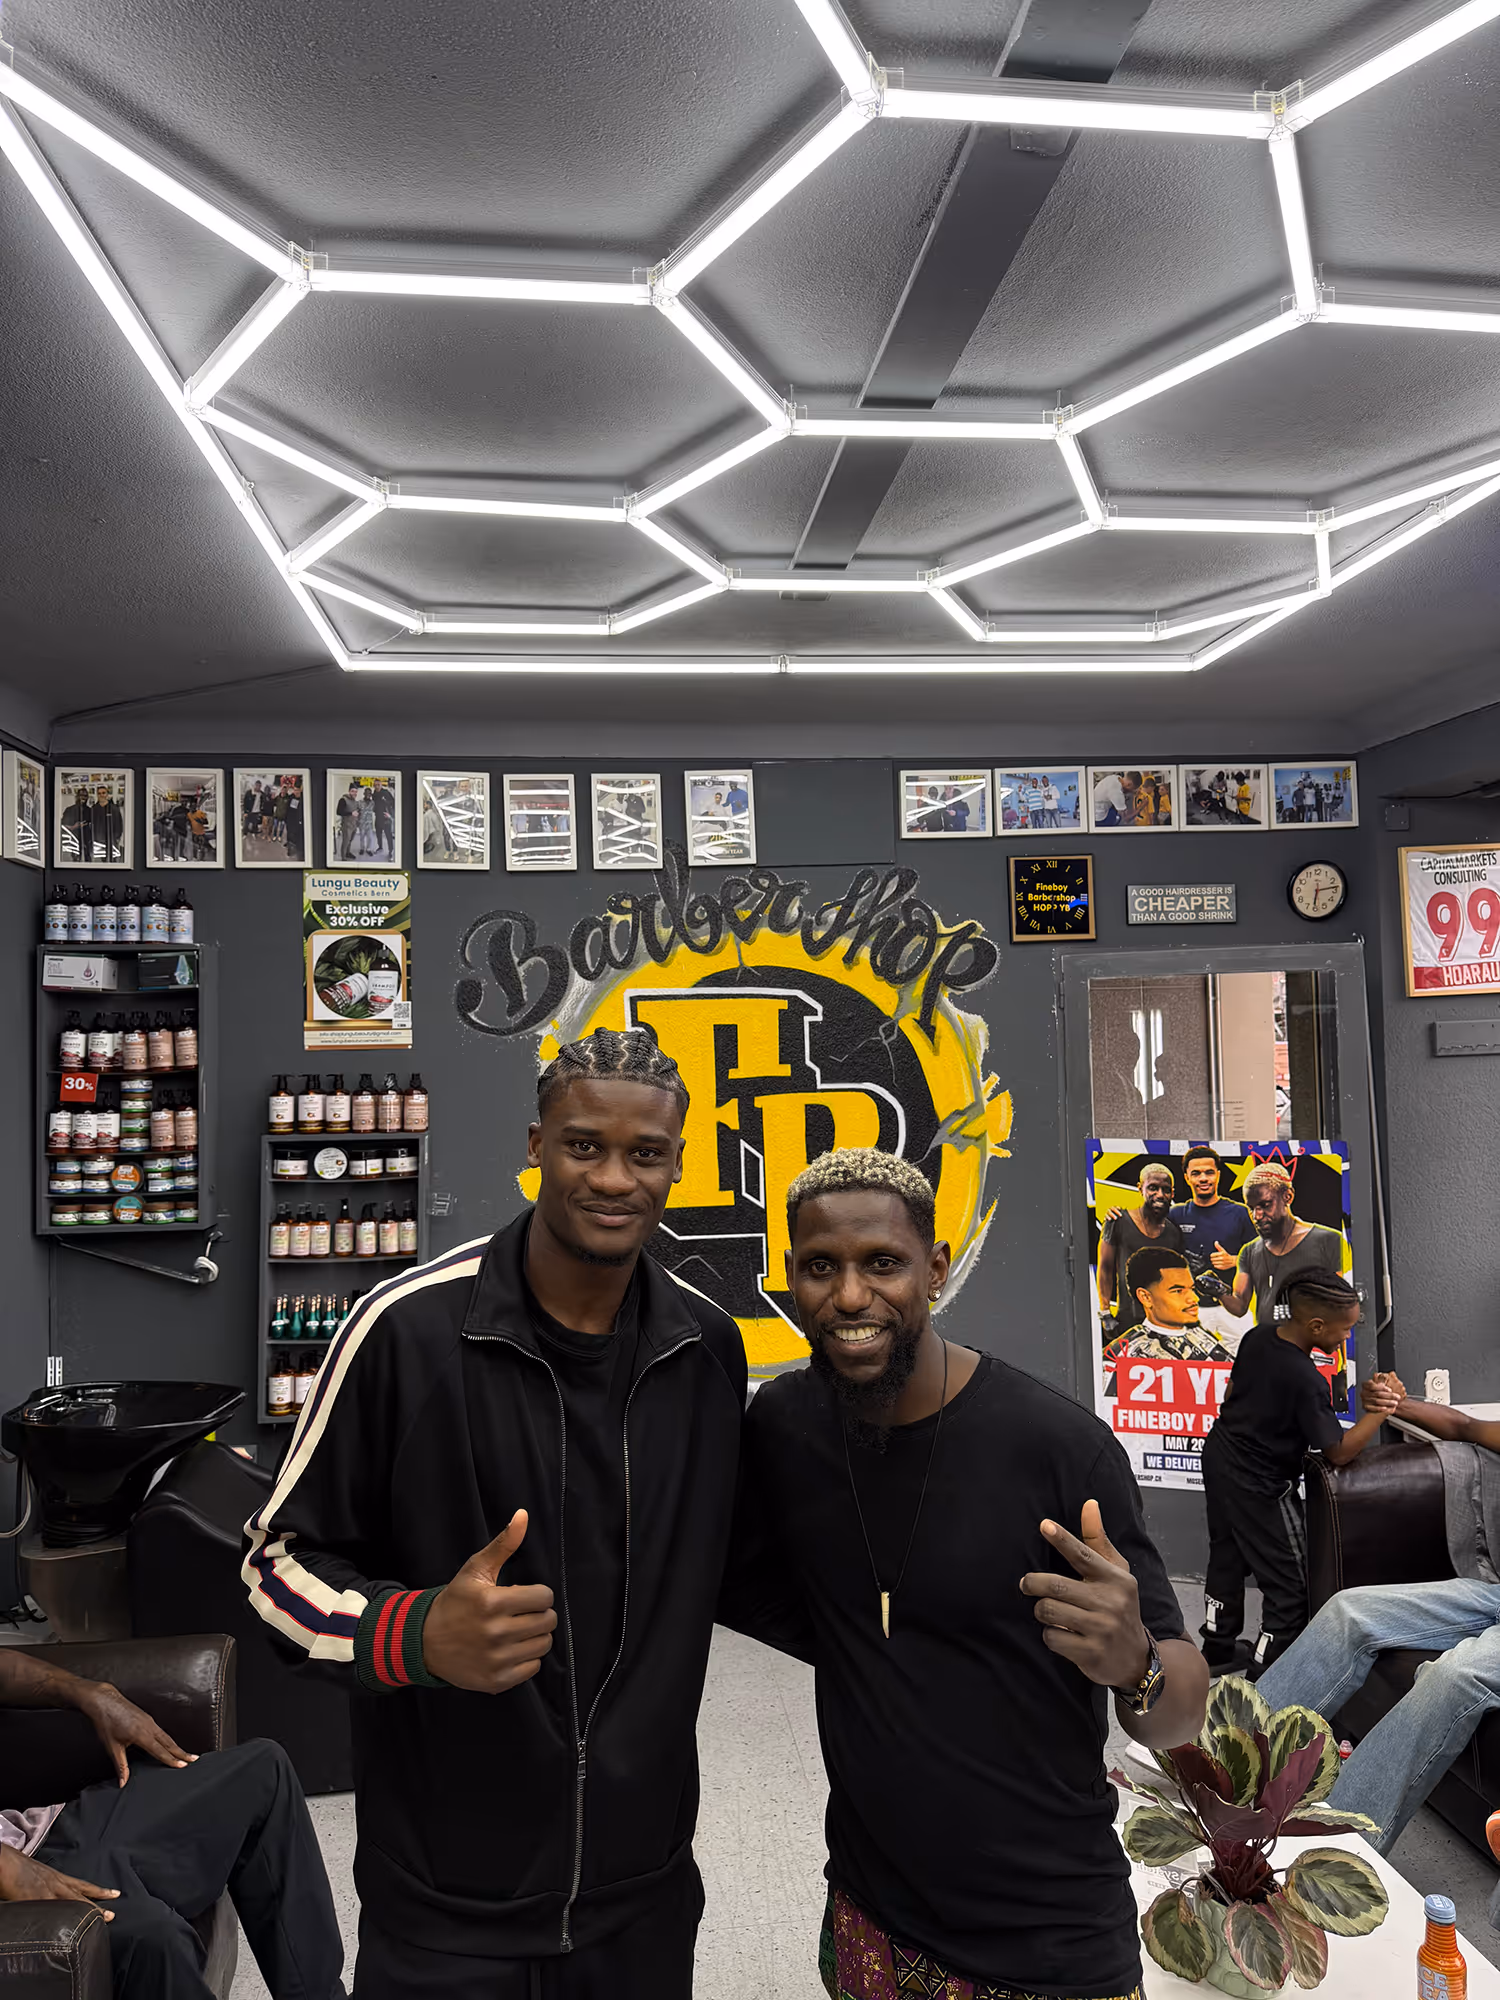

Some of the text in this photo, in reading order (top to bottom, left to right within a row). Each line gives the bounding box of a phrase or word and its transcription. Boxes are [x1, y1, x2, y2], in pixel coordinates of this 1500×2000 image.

[1433, 869, 1487, 885] CONSULTING
[311, 878, 400, 891] Lungu Beauty
[1035, 883, 1068, 893] Fineboy
[1139, 888, 1164, 896] GOOD
[1165, 887, 1223, 896] HAIRDRESSER
[321, 889, 391, 897] Cosmetics Bern
[325, 903, 389, 914] Exclusive
[1134, 896, 1231, 911] CHEAPER
[329, 916, 385, 927] 30% OFF
[1131, 911, 1234, 922] THAN A GOOD SHRINK
[1426, 887, 1500, 962] 99
[64, 1077, 94, 1091] 30%
[1128, 1364, 1174, 1403] 21
[1117, 1408, 1196, 1432] FINEBOY
[1165, 1436, 1189, 1451] MAY
[1146, 1456, 1163, 1468] WE
[1419, 1965, 1449, 1991] CE
[1420, 1984, 1450, 2000] EA
